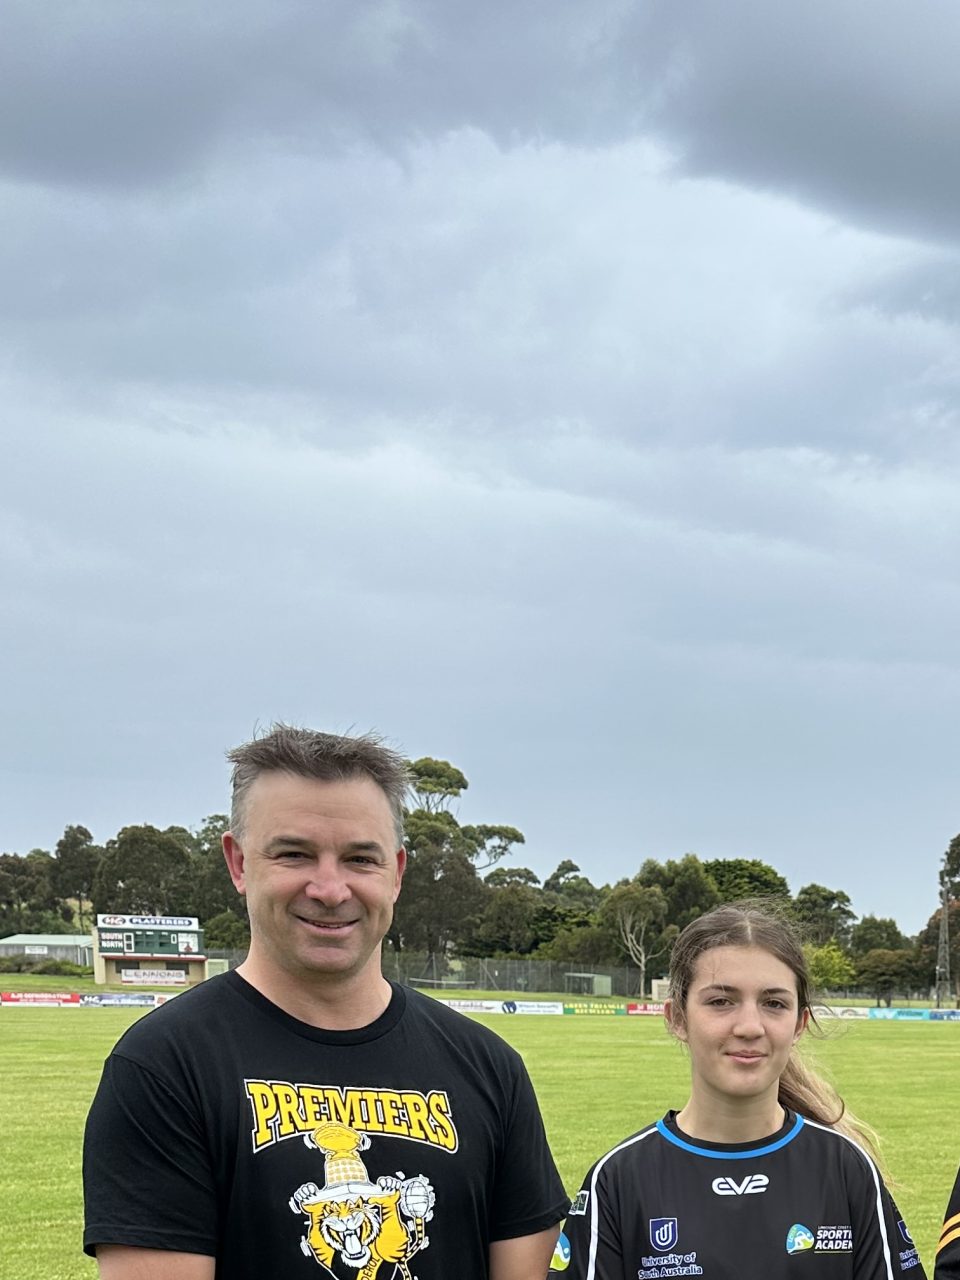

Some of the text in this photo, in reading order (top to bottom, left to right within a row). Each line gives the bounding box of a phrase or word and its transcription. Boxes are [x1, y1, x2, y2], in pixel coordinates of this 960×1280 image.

[132, 917, 190, 926] PLASTERERS
[101, 940, 124, 948] NORTH
[244, 1079, 459, 1154] PREMIERS
[641, 1252, 697, 1267] University of
[638, 1264, 703, 1280] South Australia
